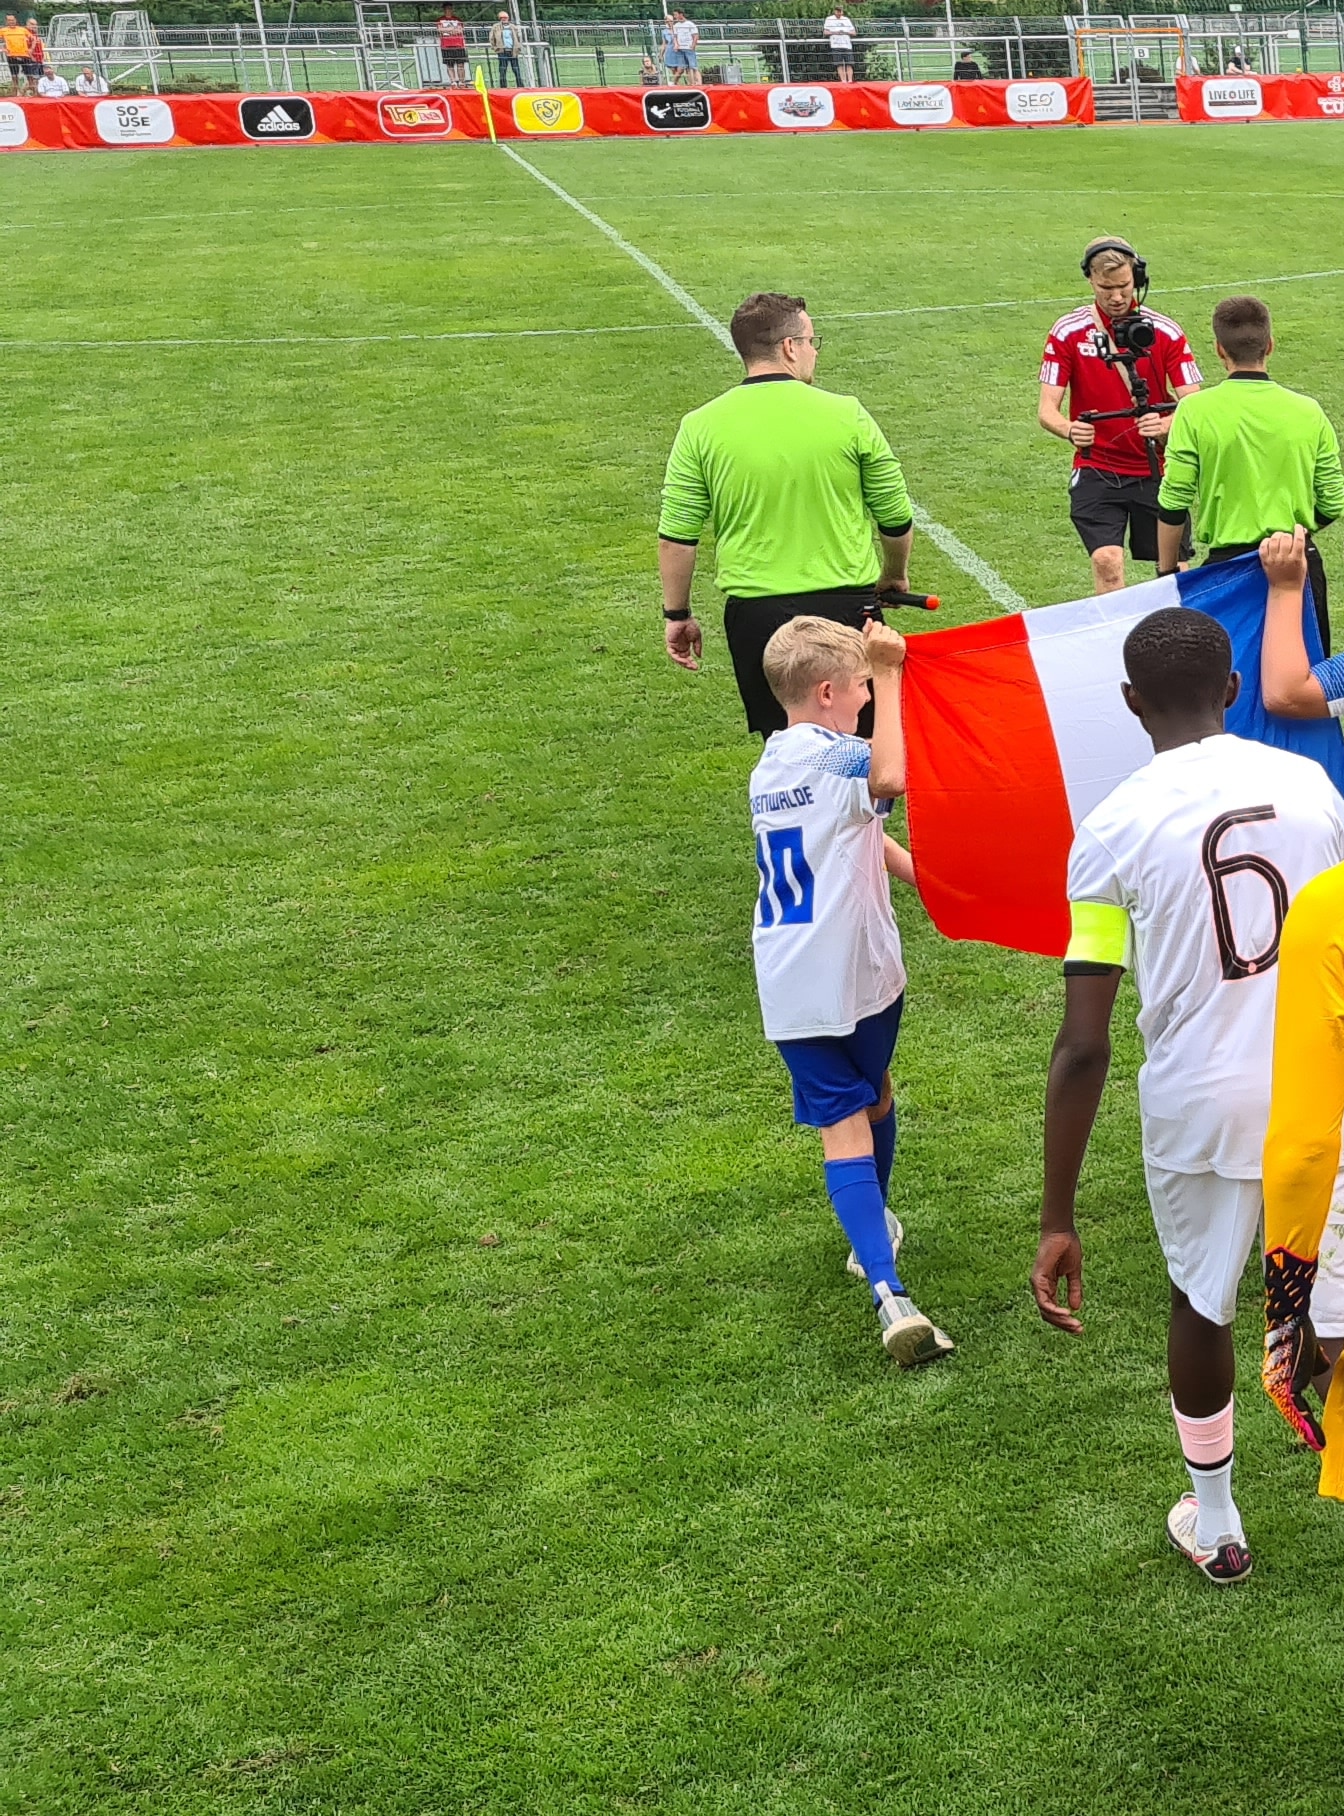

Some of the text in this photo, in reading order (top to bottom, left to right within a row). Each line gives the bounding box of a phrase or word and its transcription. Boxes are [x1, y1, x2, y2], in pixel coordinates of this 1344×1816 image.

[1138, 49, 1145, 58] B
[1017, 93, 1053, 107] SEO
[1209, 89, 1255, 100] LIVE LIFE
[116, 105, 139, 116] SO
[536, 99, 562, 118] FSV
[118, 117, 150, 127] USE
[257, 121, 300, 131] adidas
[756, 825, 815, 928] 10
[1201, 803, 1289, 982] 6
